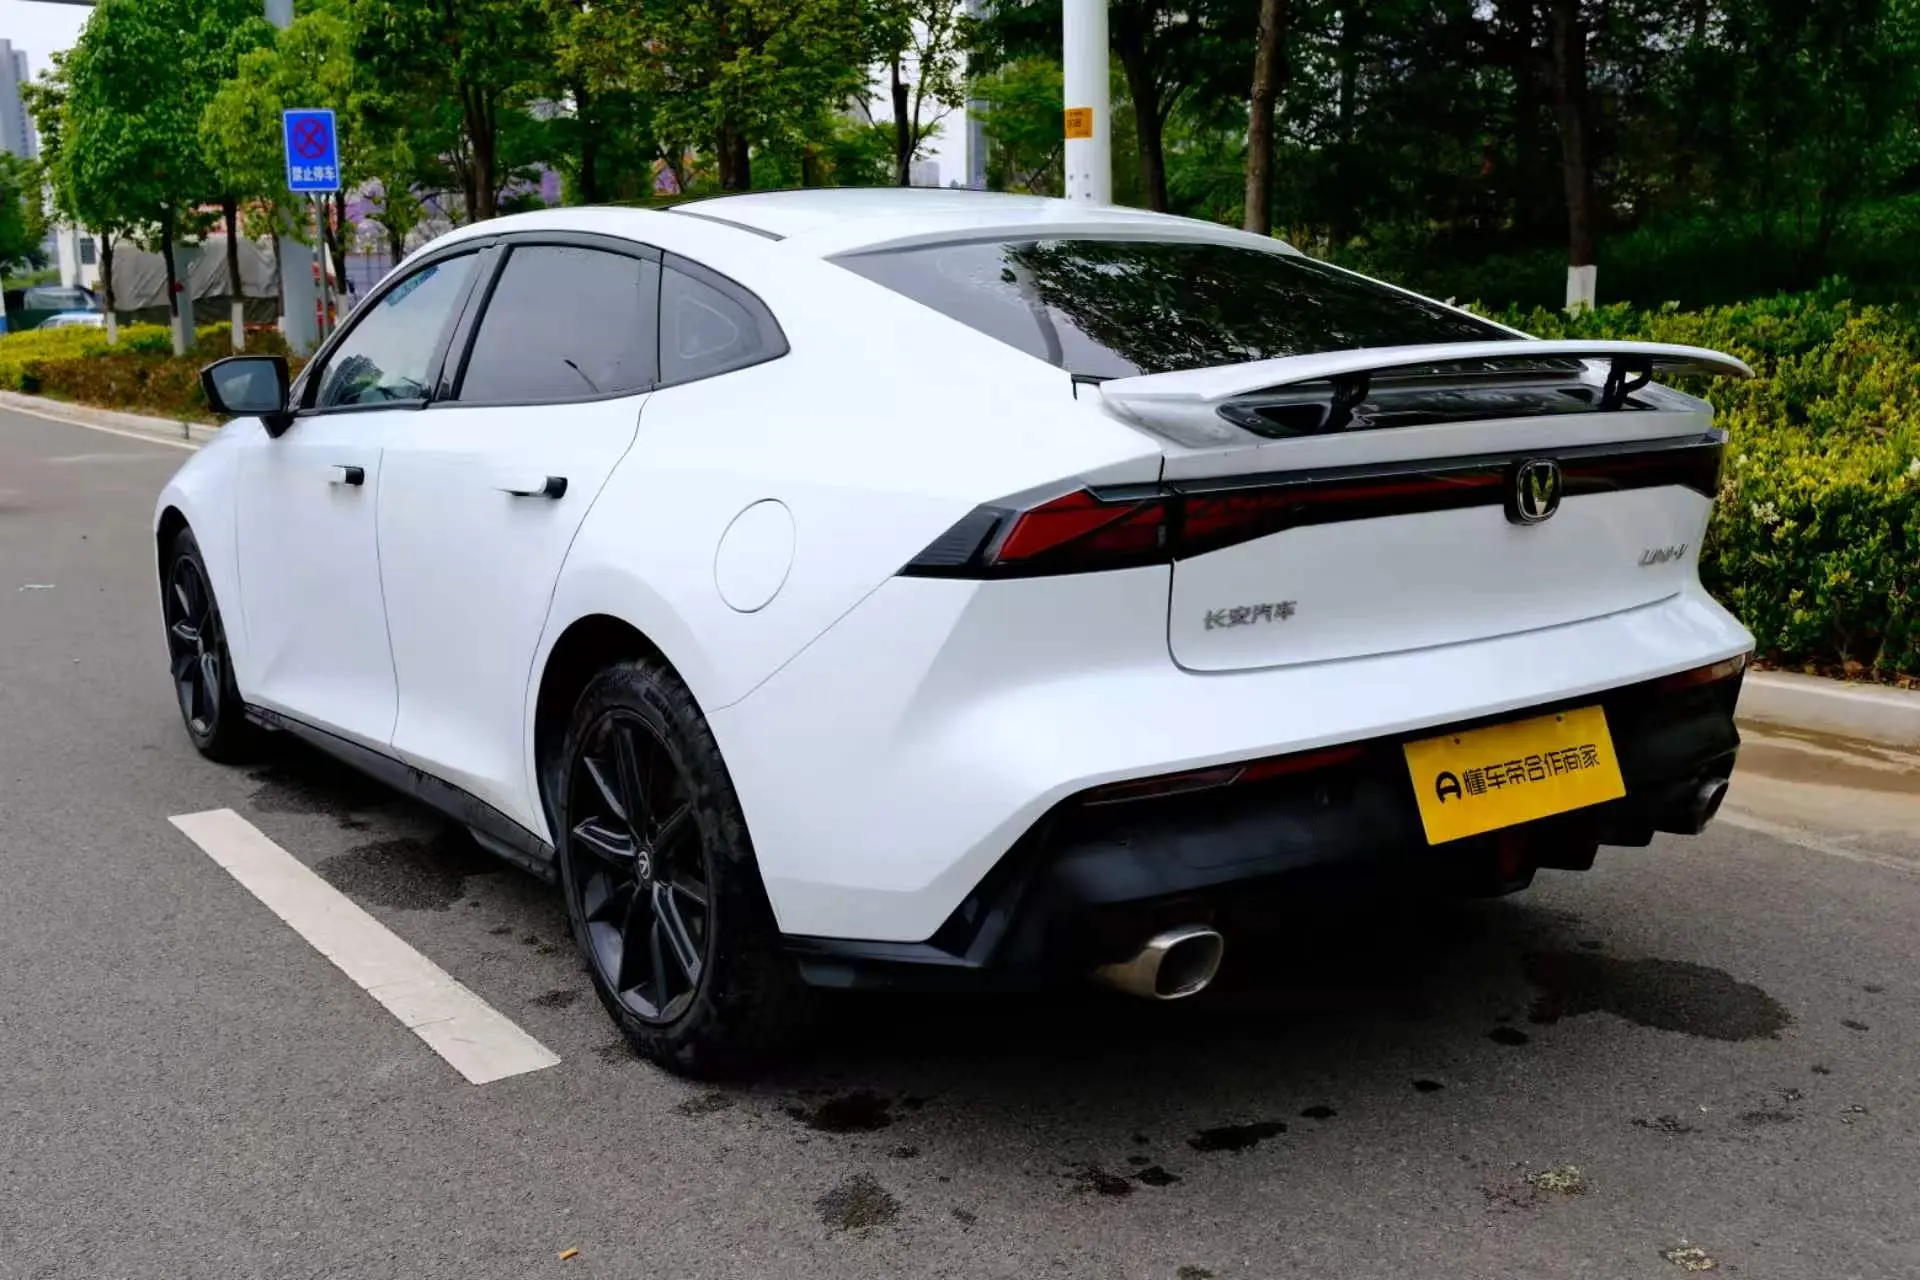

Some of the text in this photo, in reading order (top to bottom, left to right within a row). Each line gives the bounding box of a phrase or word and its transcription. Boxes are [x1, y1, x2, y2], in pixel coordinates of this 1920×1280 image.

[1203, 600, 1297, 631] 长安汽车
[1463, 743, 1601, 796] 懂车帝合作商家
